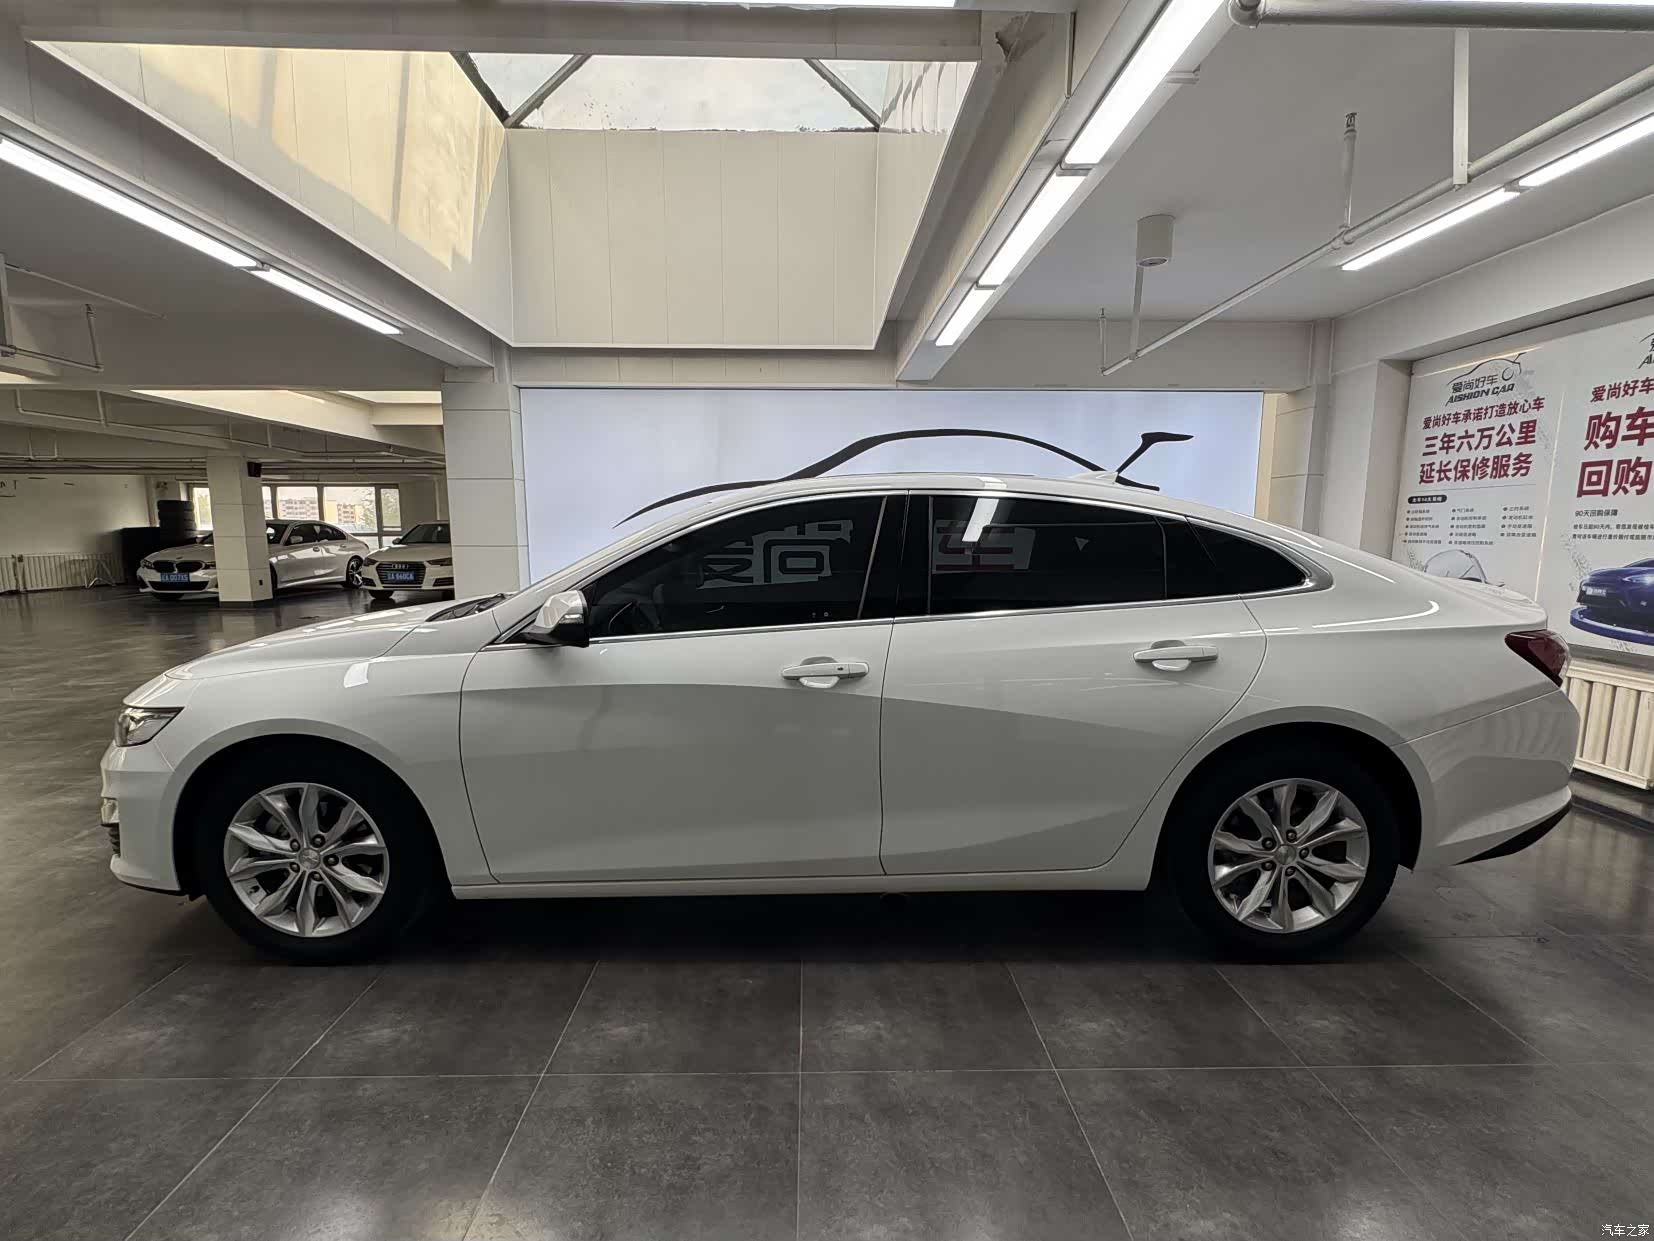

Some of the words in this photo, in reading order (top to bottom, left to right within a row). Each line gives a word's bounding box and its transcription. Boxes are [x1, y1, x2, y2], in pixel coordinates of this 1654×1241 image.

[1445, 389, 1490, 407] AISHION
[1491, 383, 1515, 396] CAR
[1452, 374, 1499, 394] 爱尚好车
[1590, 377, 1654, 403] 爱尚好车
[1423, 396, 1545, 430] 爱尚好车承诺打造放心车
[1583, 406, 1654, 451] 购车
[1422, 419, 1538, 457] 三年六万公里
[1419, 452, 1533, 485] 延长保修服务
[1577, 456, 1653, 498] 回购
